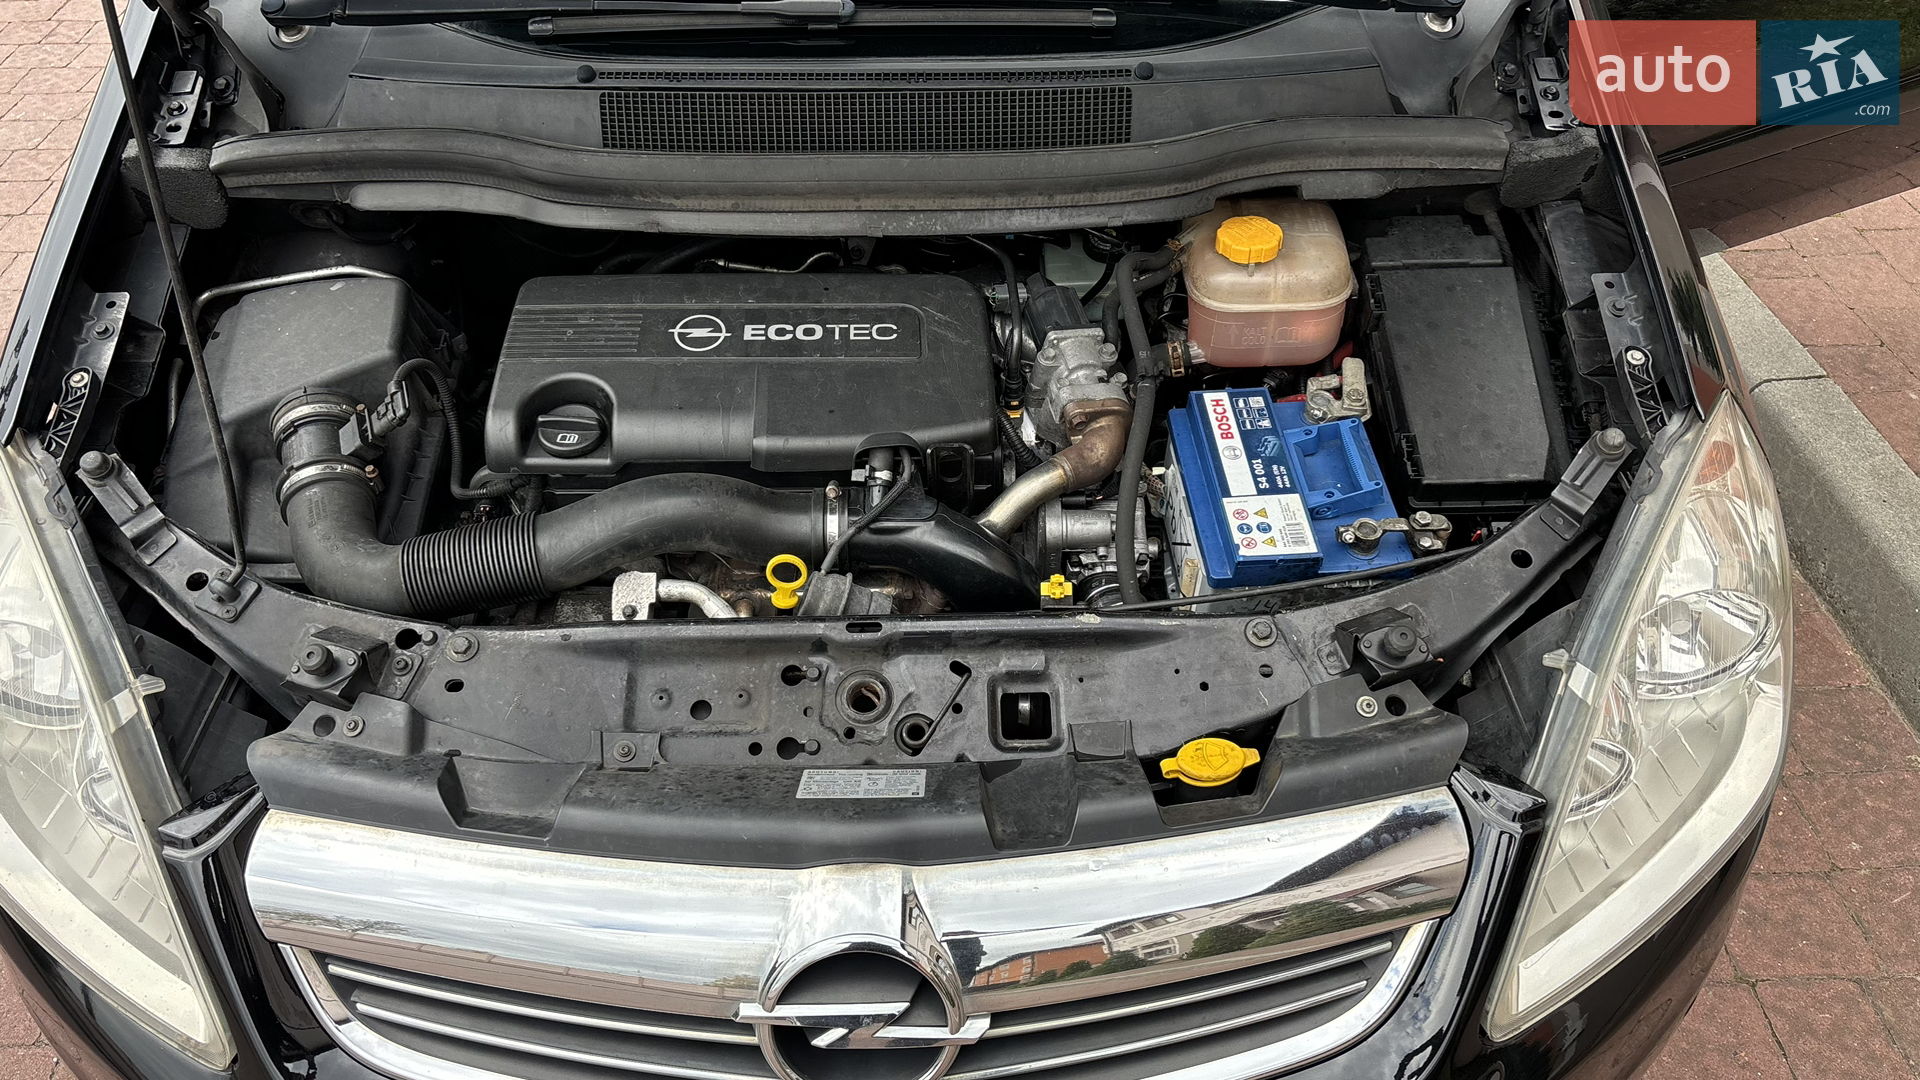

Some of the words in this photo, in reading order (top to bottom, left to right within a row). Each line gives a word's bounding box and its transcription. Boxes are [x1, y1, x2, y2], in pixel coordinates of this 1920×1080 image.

[743, 323, 898, 340] ECOTEC
[1210, 398, 1235, 440] BOSCH
[1252, 458, 1265, 475] 001
[1257, 476, 1269, 489] S4
